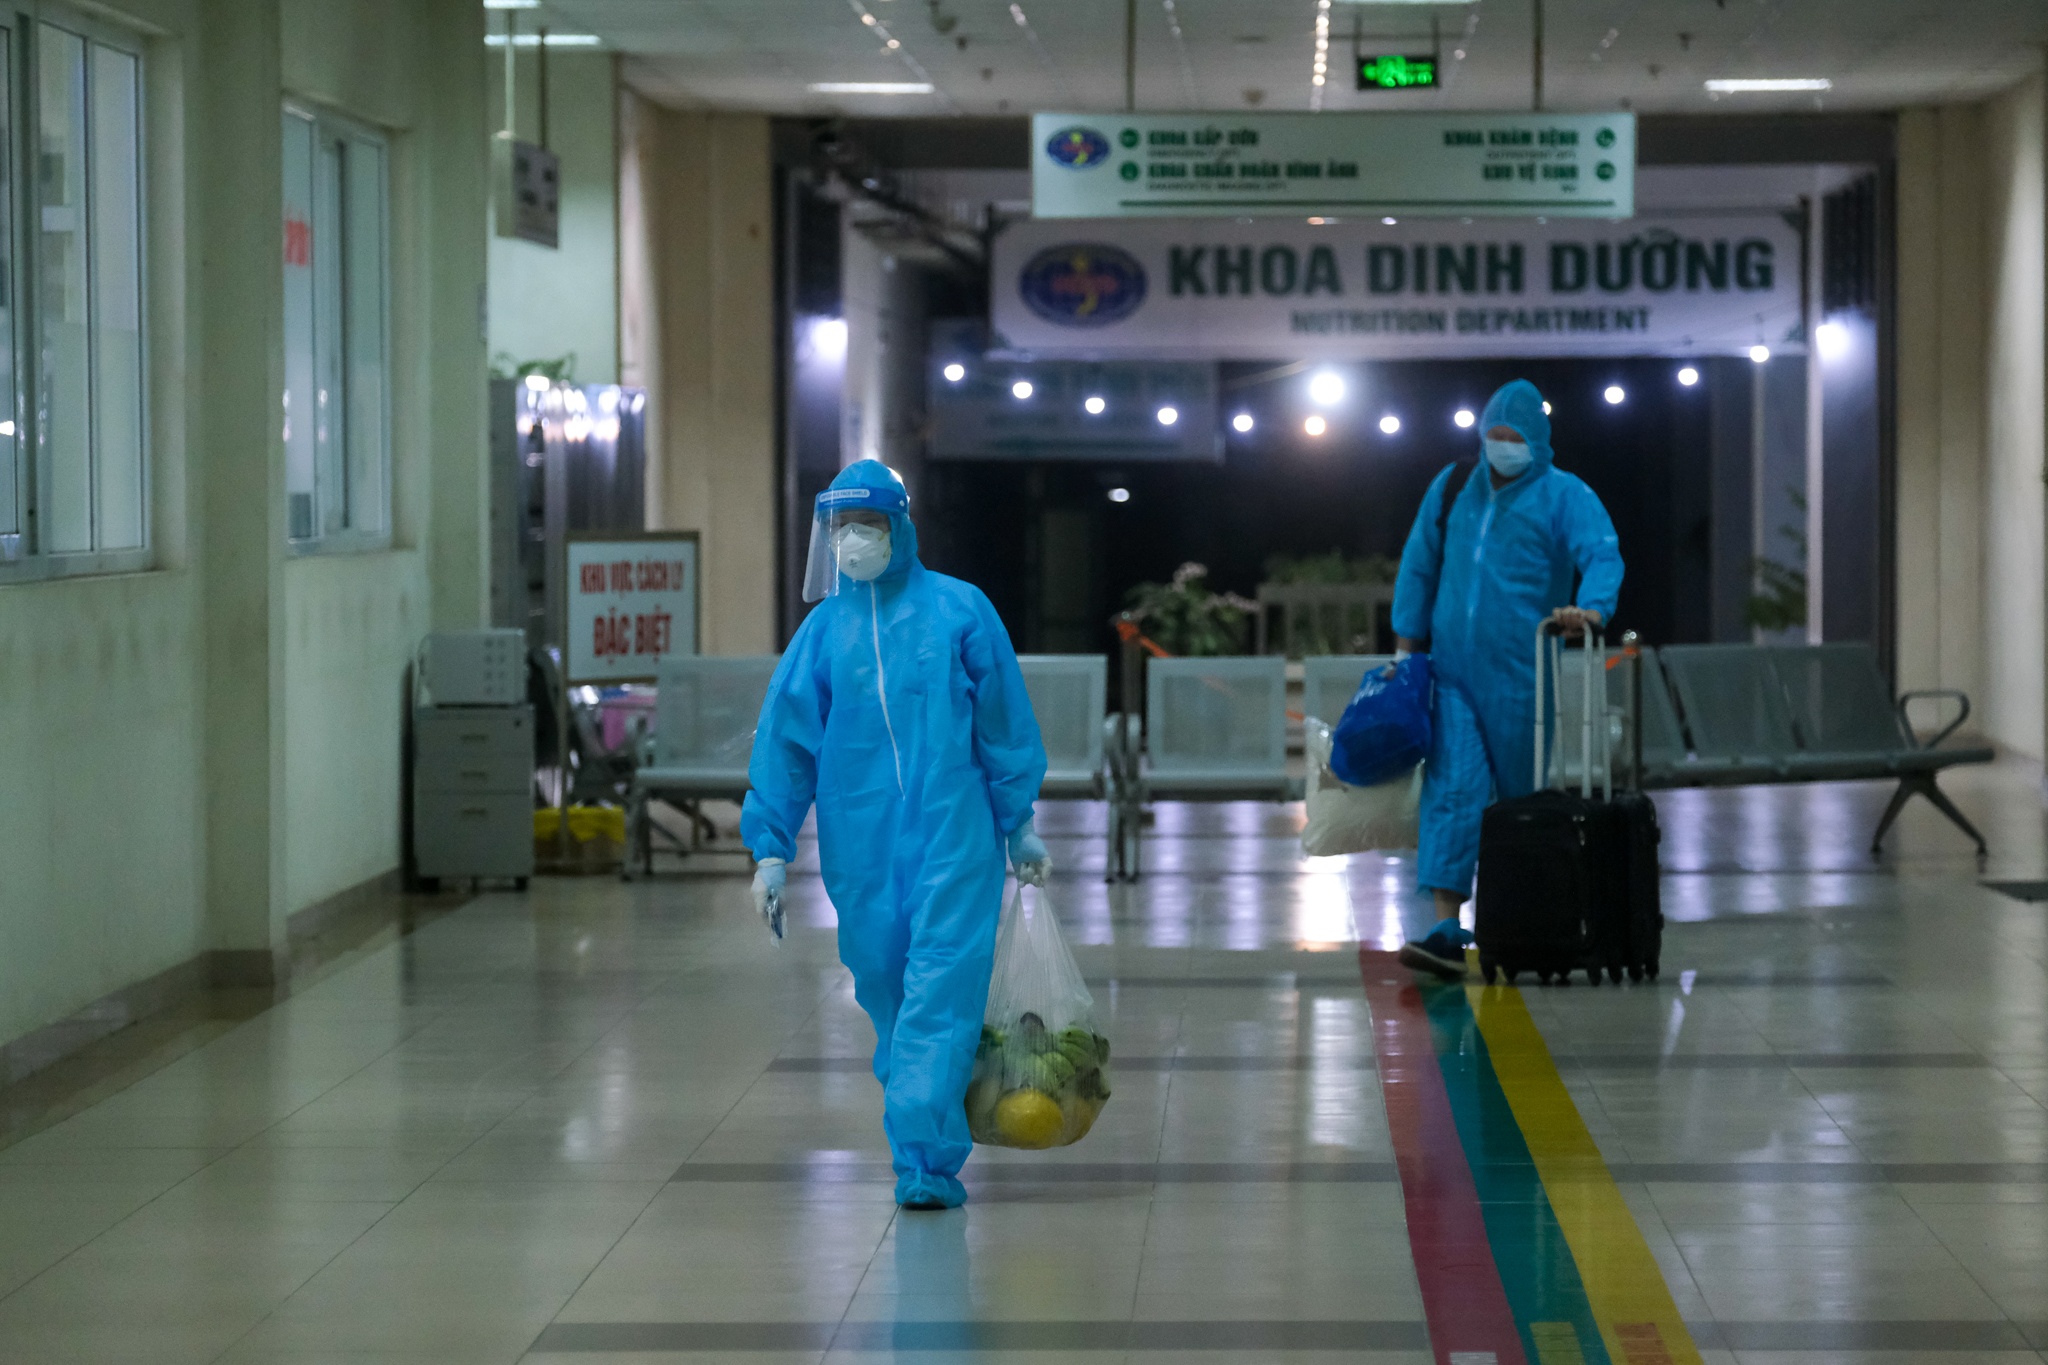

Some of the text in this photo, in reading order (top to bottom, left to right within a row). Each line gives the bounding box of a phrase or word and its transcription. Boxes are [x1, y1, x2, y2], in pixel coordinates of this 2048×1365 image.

[1168, 244, 1342, 297] KHOA
[1366, 242, 1525, 295] DINH
[1547, 229, 1774, 293] DƯỠNG
[1291, 307, 1651, 336] NUTRITION DEPARTMENT
